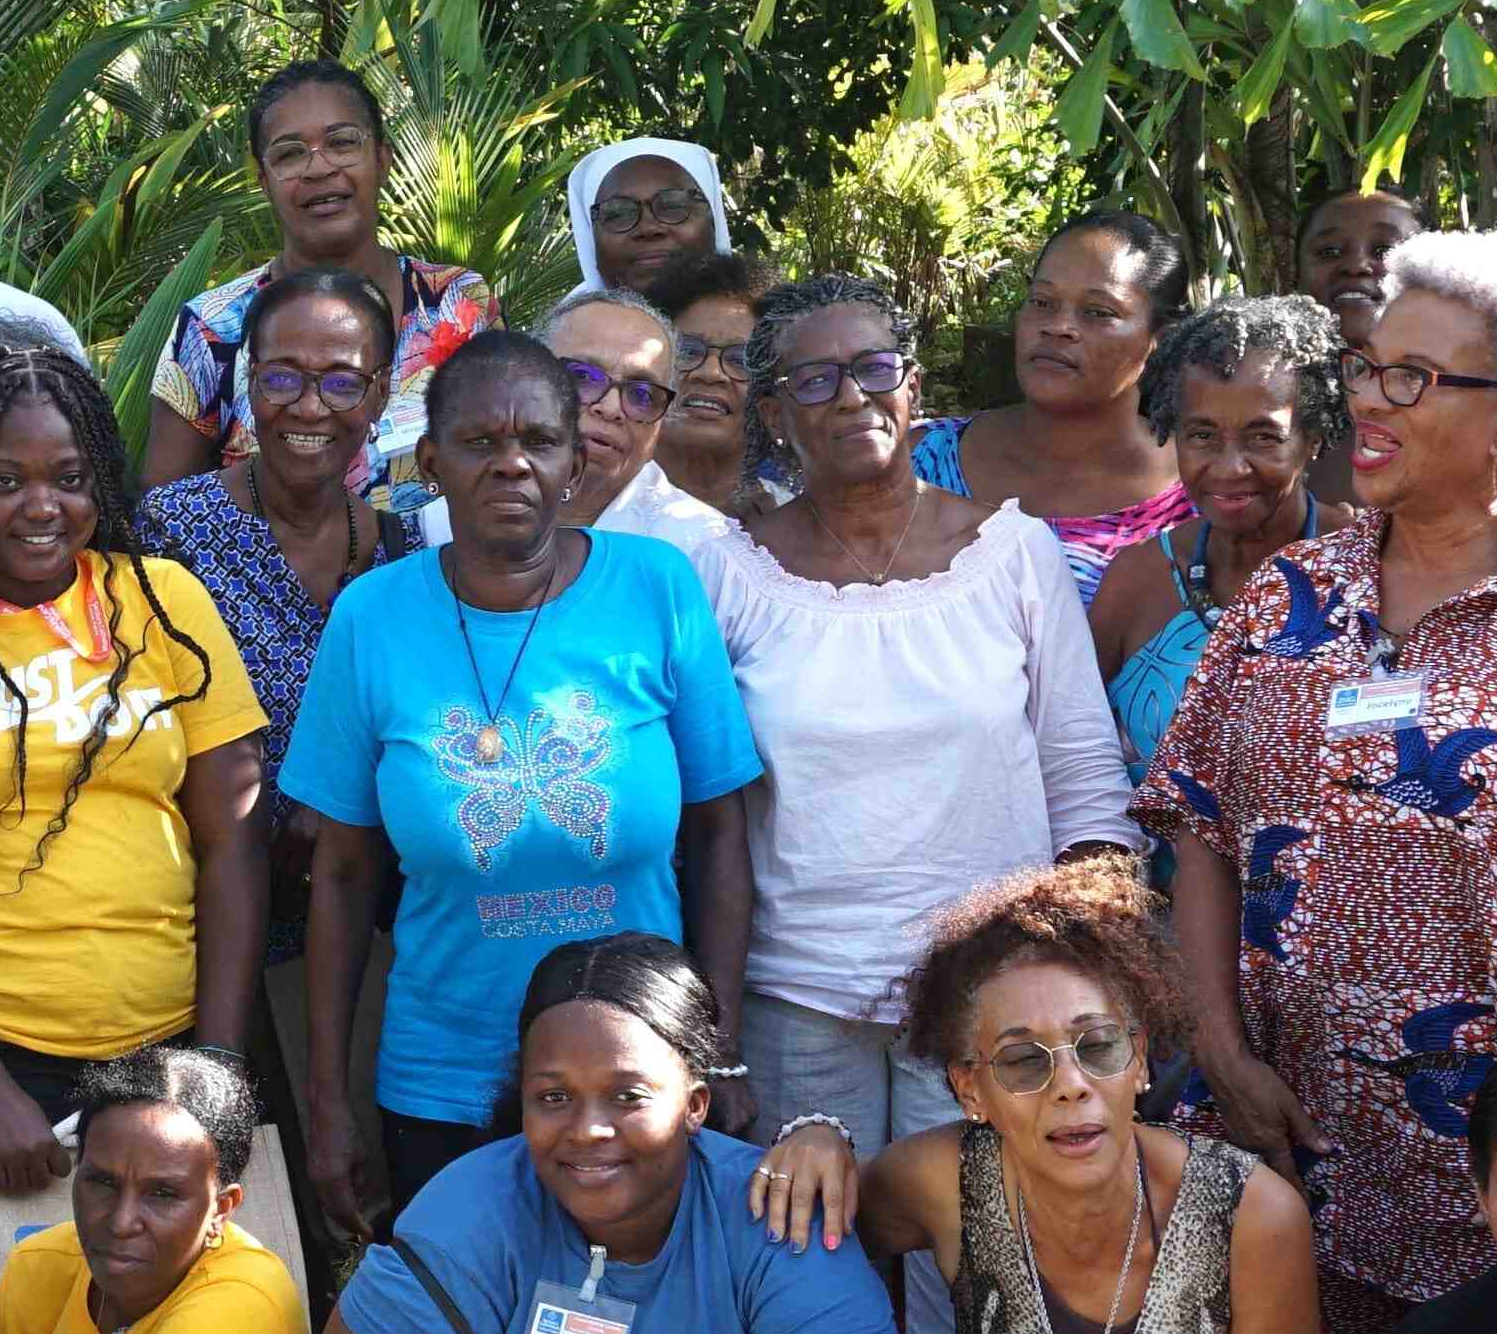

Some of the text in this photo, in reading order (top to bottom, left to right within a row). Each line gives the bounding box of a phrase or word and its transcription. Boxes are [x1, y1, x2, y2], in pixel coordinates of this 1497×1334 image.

[476, 883, 616, 921] MEXICO
[481, 911, 615, 940] COSTA MAYA
